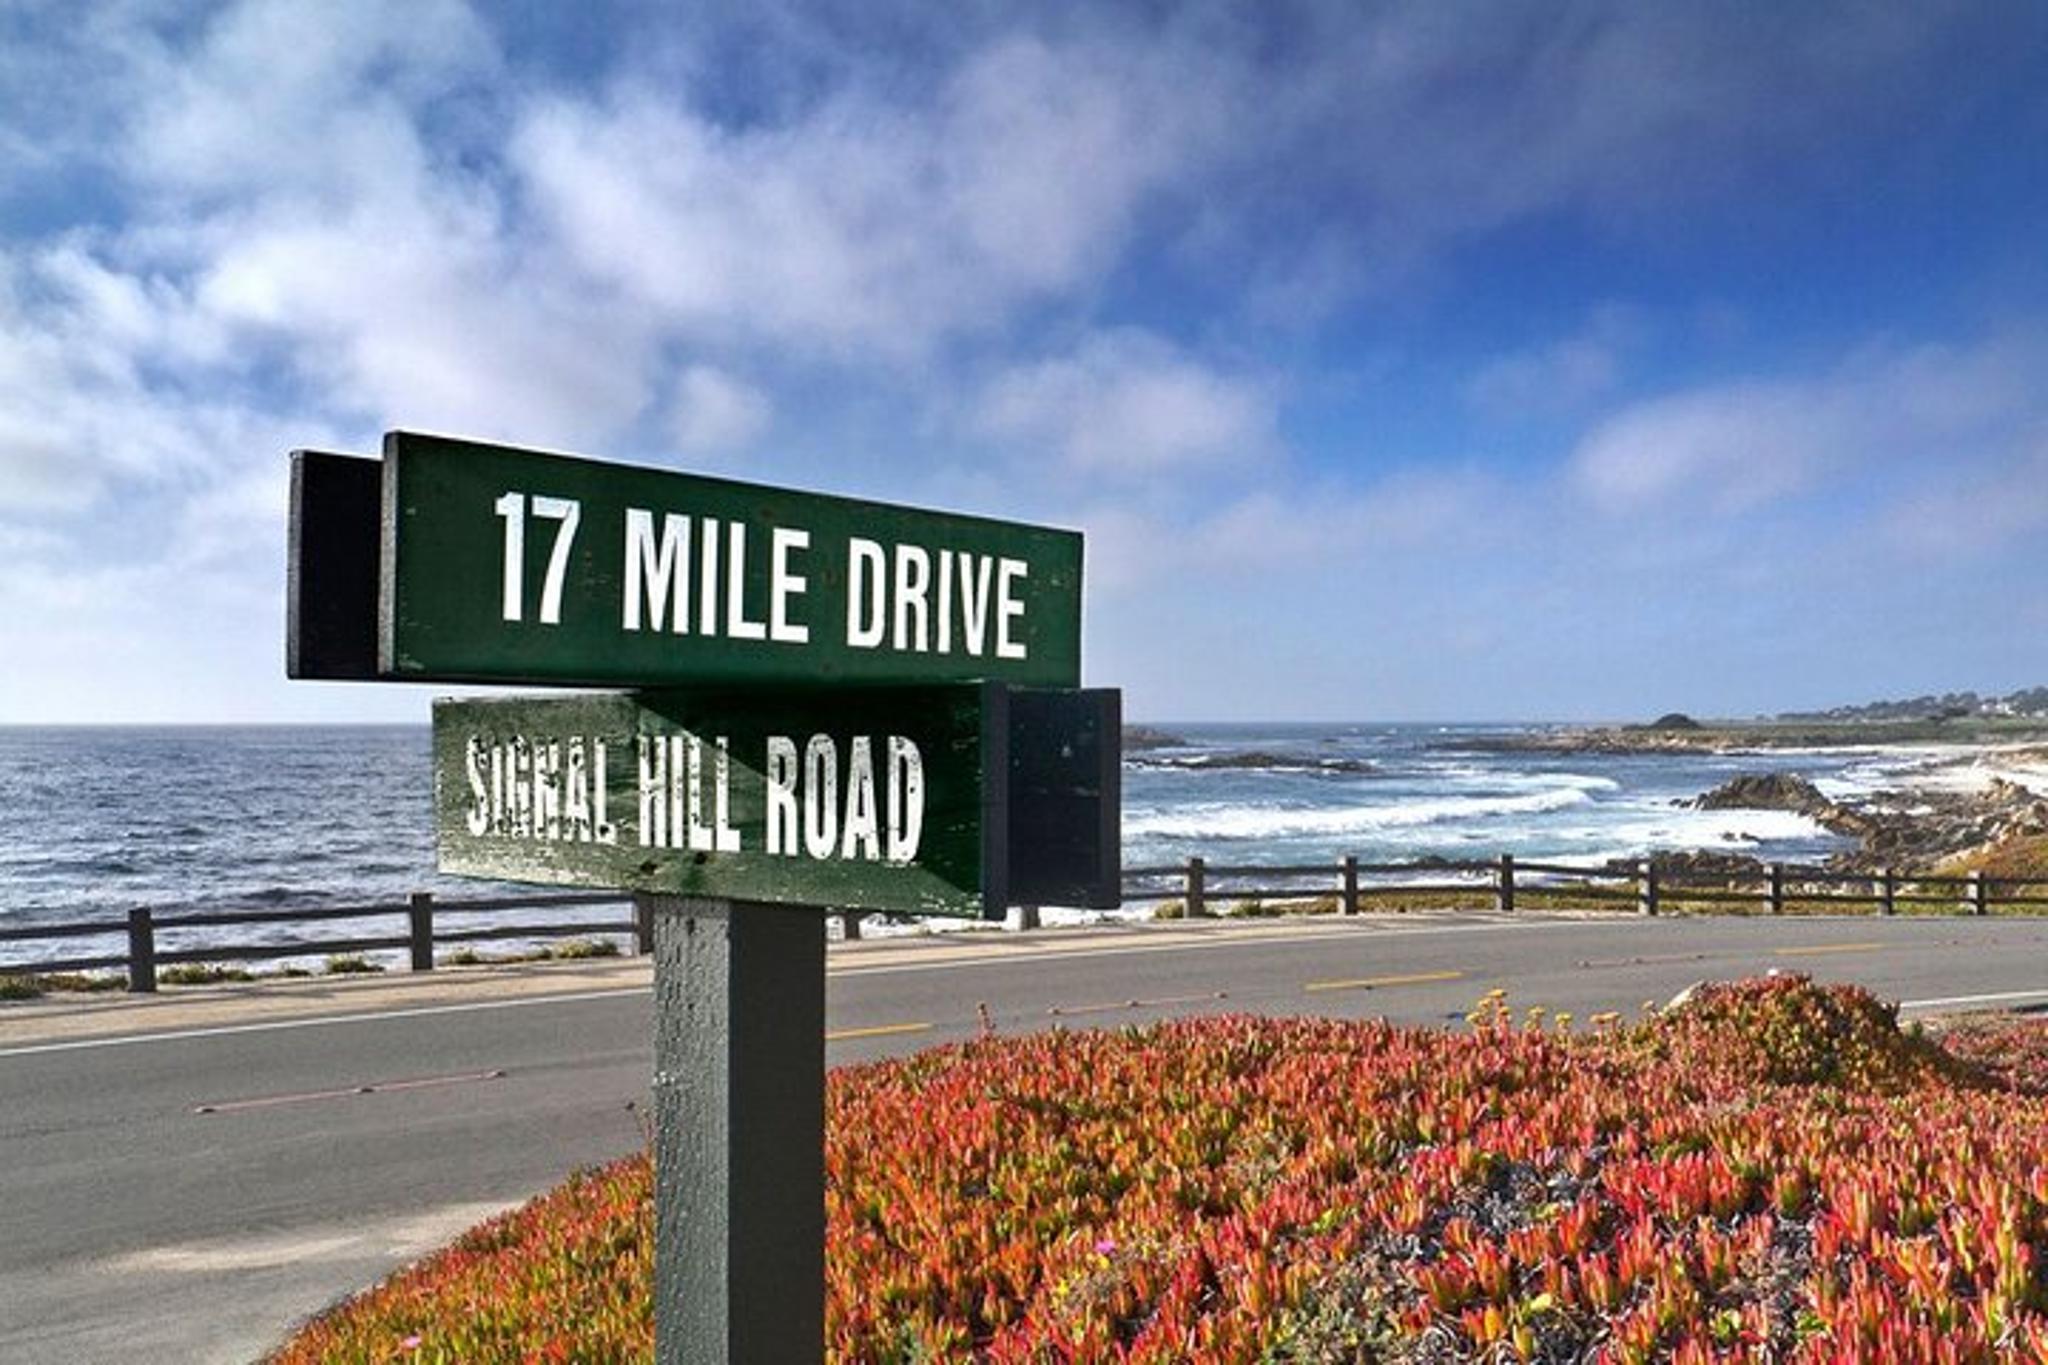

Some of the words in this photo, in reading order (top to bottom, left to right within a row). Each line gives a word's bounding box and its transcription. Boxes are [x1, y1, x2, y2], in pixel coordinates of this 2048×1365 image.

[494, 491, 581, 624] 17
[623, 508, 809, 645] MILE
[847, 537, 1028, 659] DRIVE
[466, 734, 617, 846] SIGNAL
[638, 734, 742, 852] HILL
[766, 733, 925, 863] ROAD
